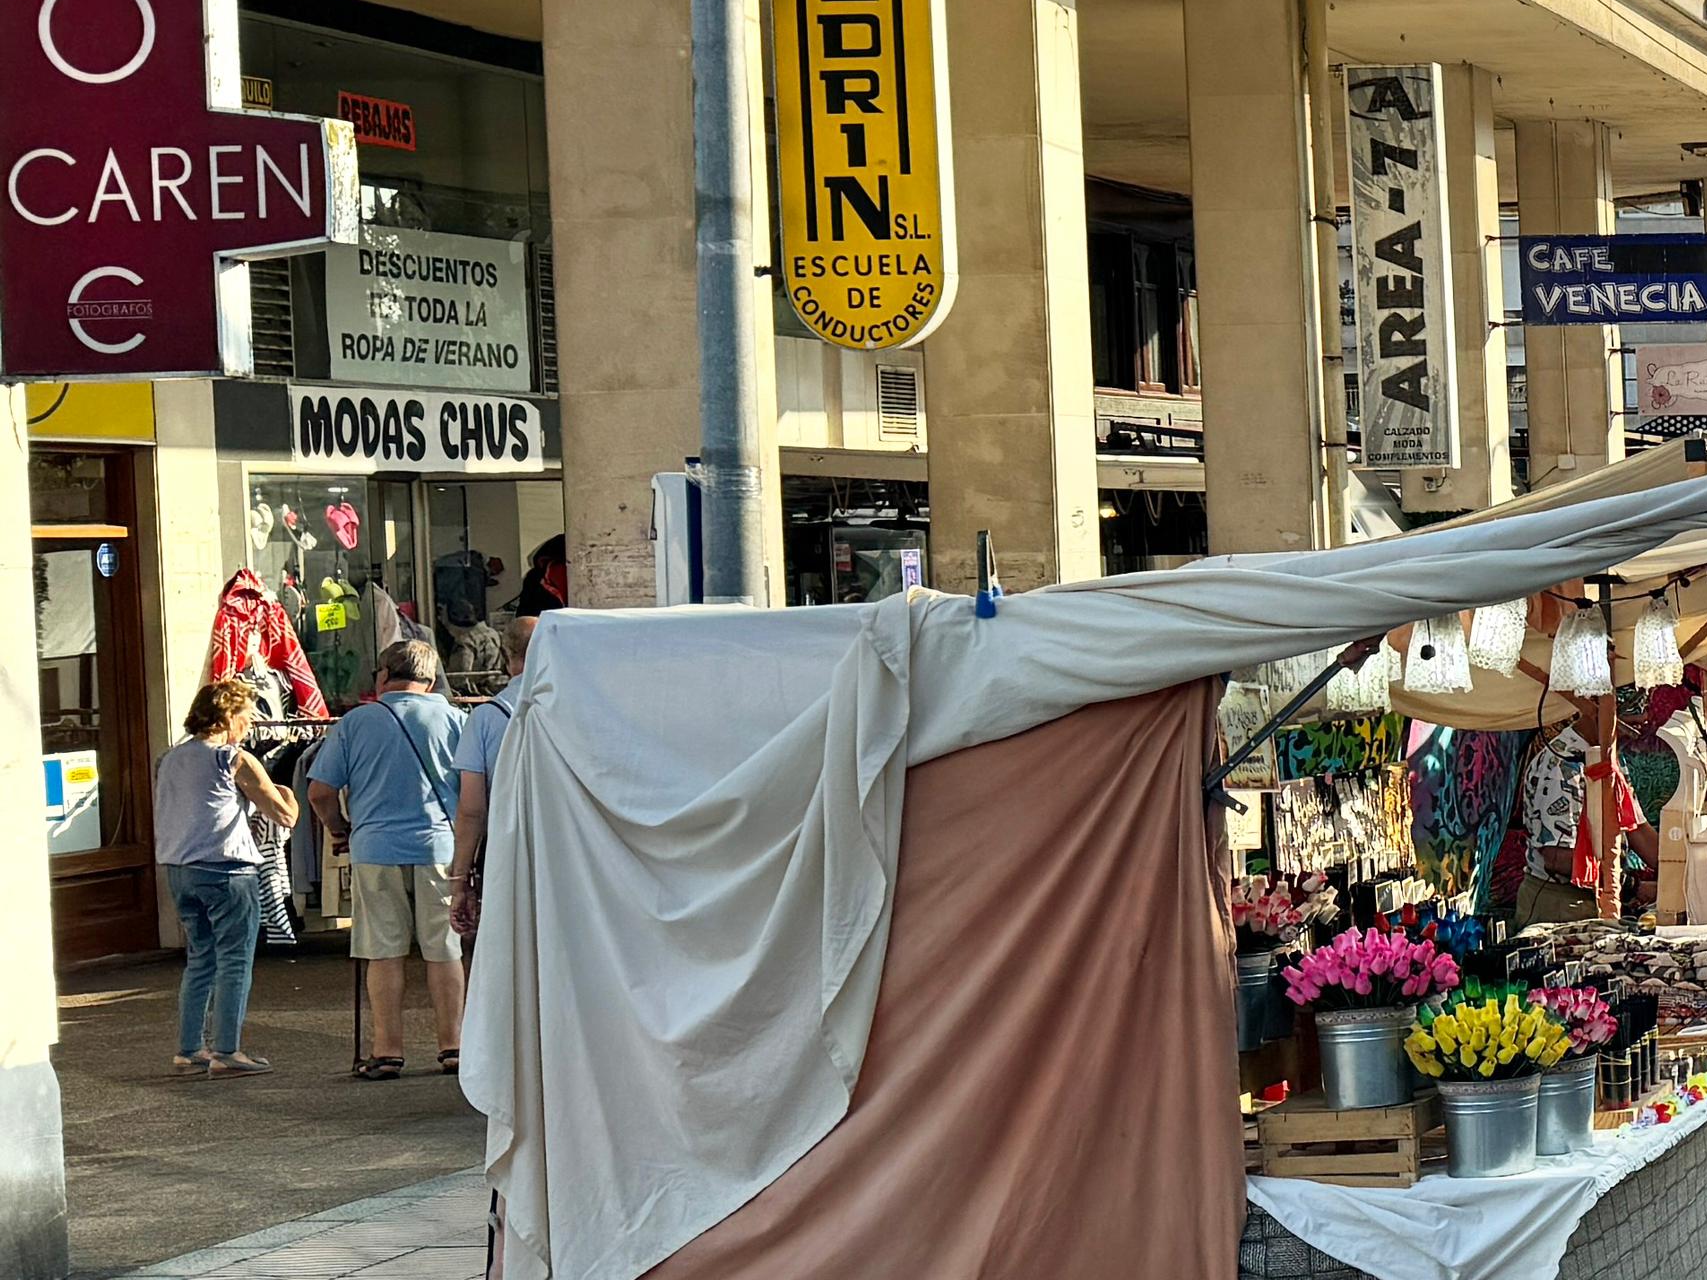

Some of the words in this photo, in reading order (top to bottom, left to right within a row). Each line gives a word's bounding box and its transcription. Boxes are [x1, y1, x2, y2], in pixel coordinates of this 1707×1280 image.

[8, 143, 312, 226] CAREN
[893, 213, 931, 241] S.L.
[358, 248, 498, 289] DESCUENTOS
[793, 252, 931, 280] ESCUELA
[1528, 242, 1615, 273] CAFE
[404, 295, 460, 325] TODA
[464, 304, 488, 327] LA
[793, 280, 934, 344] CONDUCTORES
[846, 286, 882, 310] DE
[341, 334, 396, 362] ROPA
[402, 338, 429, 363] DE
[433, 339, 519, 370] VERANO
[299, 395, 427, 462] MODAS
[440, 400, 530, 463] CHUS
[1384, 426, 1430, 437] CALZADO
[1393, 439, 1424, 449] MODA
[1368, 451, 1450, 462] COMPLEMENTOS
